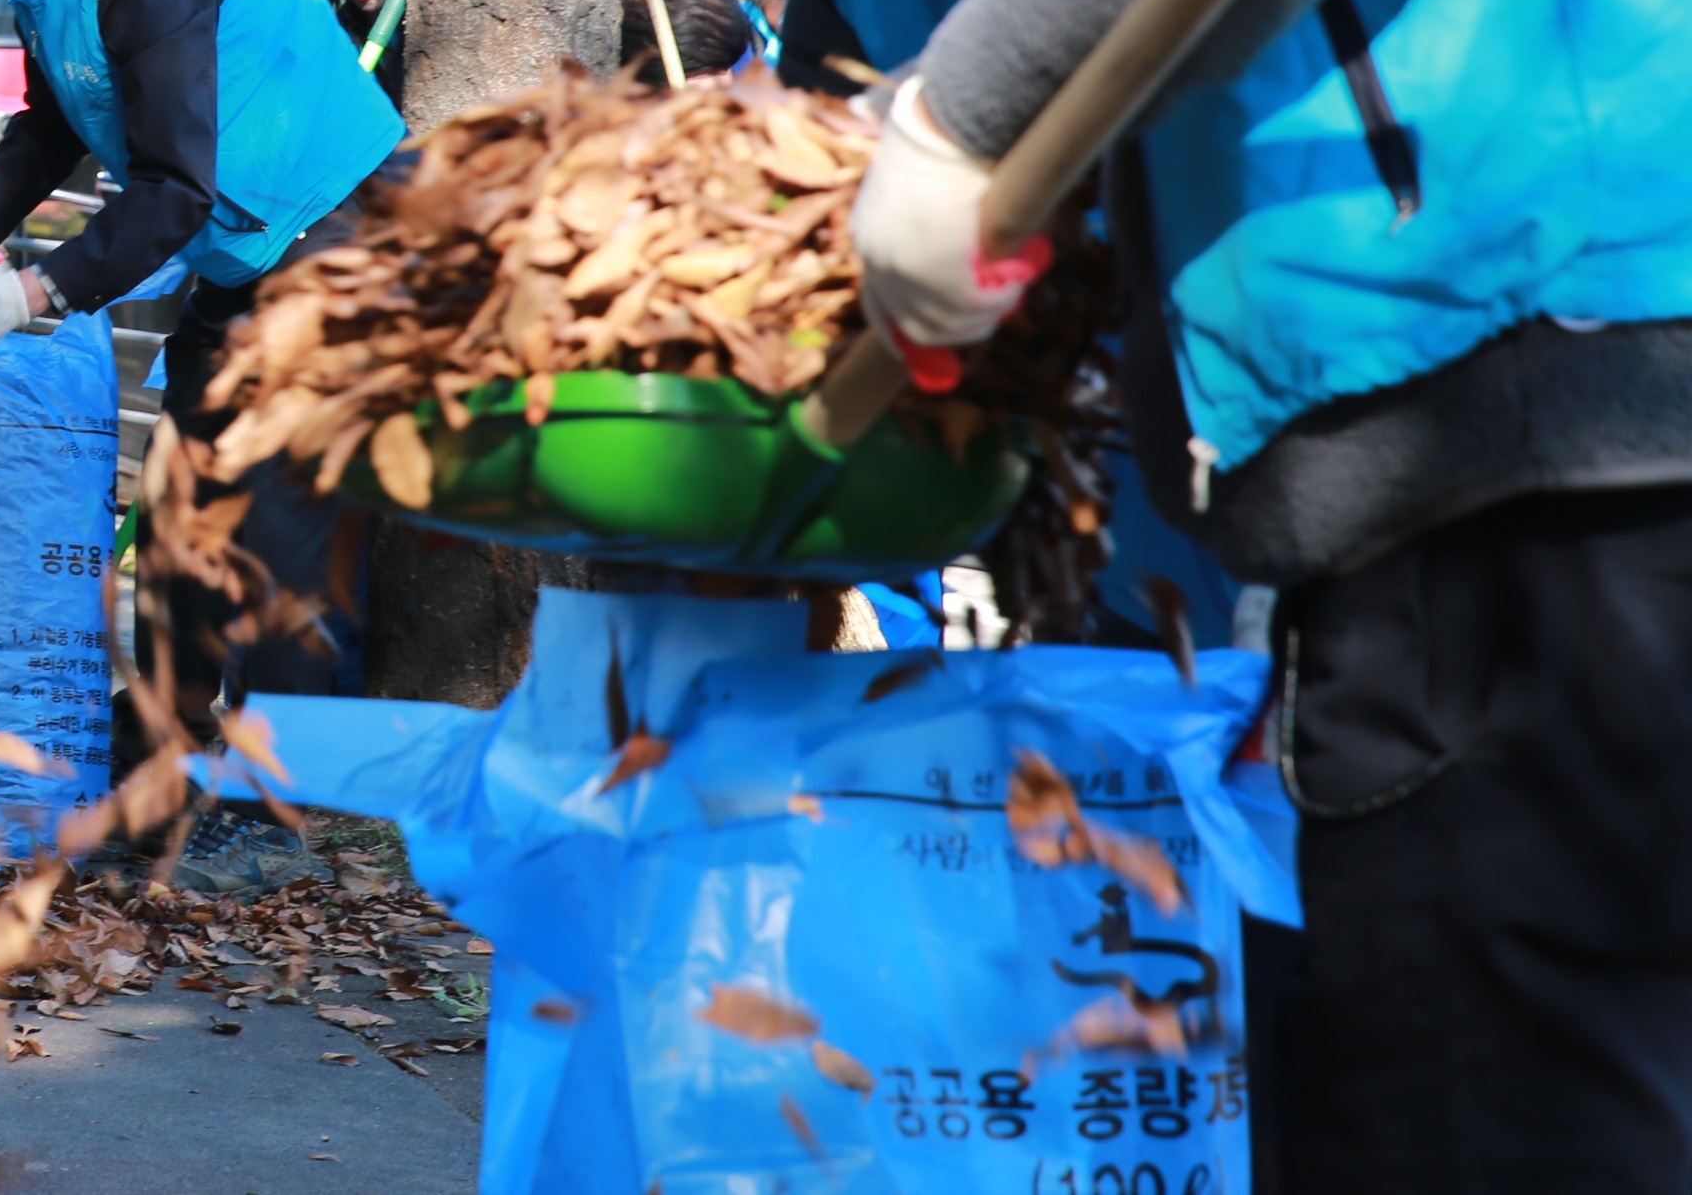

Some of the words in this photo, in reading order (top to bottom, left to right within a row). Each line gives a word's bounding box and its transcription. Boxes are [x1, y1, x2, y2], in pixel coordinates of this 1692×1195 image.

[40, 543, 102, 578] 공공용
[11, 627, 24, 645] 1.
[29, 626, 69, 647] 재활용
[11, 684, 25, 701] 2.
[51, 685, 85, 705] 봉투는
[882, 1067, 1036, 1142] 공공용
